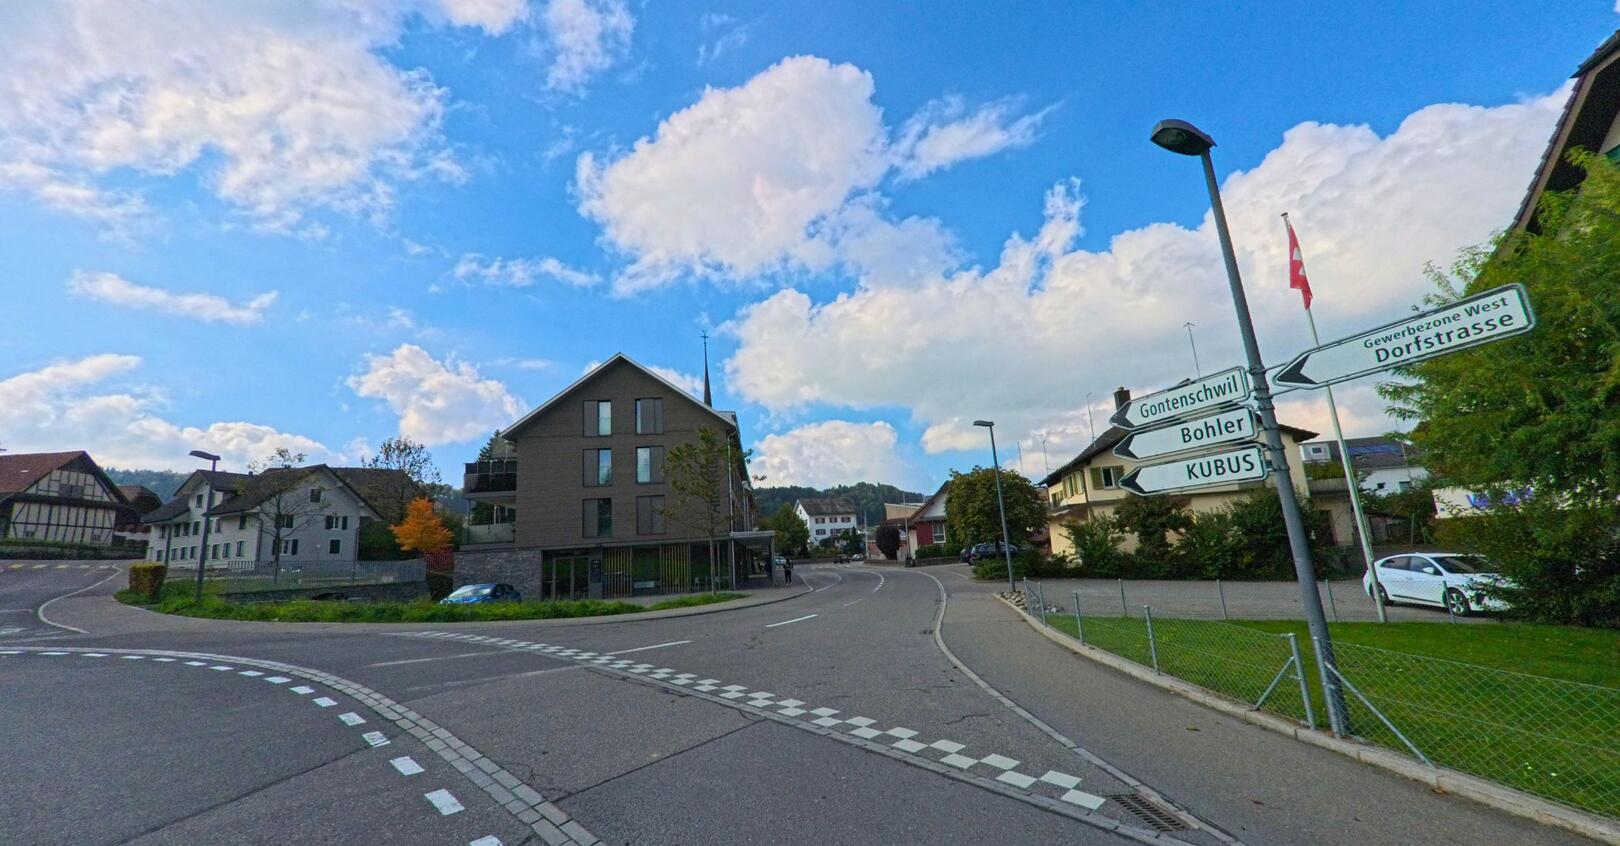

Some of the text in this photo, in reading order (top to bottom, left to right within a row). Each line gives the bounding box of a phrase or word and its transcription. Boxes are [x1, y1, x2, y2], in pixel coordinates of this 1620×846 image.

[1364, 297, 1508, 349] Gewerbezone West
[1375, 314, 1514, 363] Dorfstrasse
[1140, 375, 1238, 418] Gontenschwil
[1181, 418, 1244, 443] Bohler
[1187, 454, 1255, 480] KUBUS
